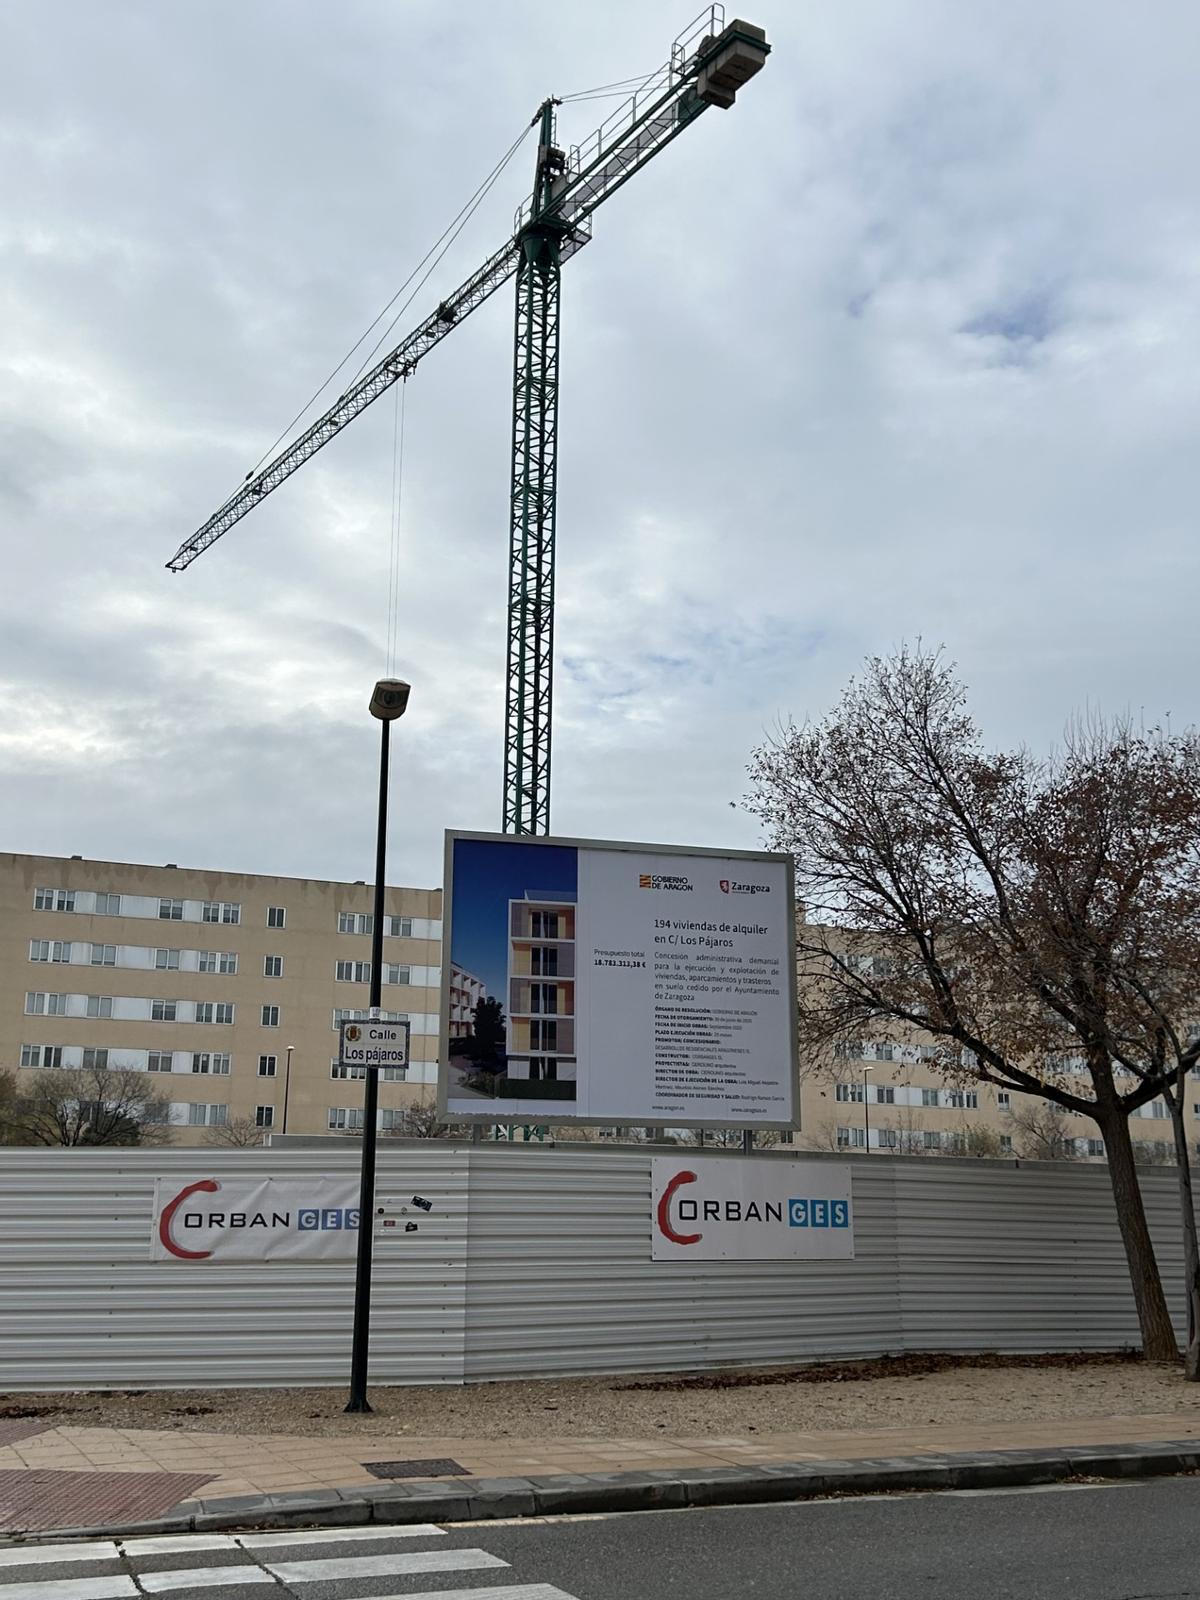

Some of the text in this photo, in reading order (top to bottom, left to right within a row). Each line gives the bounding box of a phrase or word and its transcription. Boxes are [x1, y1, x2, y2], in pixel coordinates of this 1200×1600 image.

[652, 875, 688, 884] GOBIERNO
[732, 882, 770, 894] Zaragoza
[654, 920, 768, 935] 194 viviendas de alquiler
[668, 935, 678, 946] C/
[680, 936, 696, 945] Los
[698, 936, 734, 948] Pájaros
[594, 949, 630, 957] Presupuesto
[654, 952, 779, 965] Concesión administrativa demanial
[685, 964, 716, 972] ejecución
[729, 966, 766, 975] explotación
[655, 973, 688, 982] viviendas,
[689, 975, 737, 984] aparcamientos
[734, 987, 780, 995] Ayuntamiento
[664, 993, 694, 1002] Zaragoza
[370, 1030, 396, 1040] Calle
[346, 1046, 403, 1063] Los pájaros
